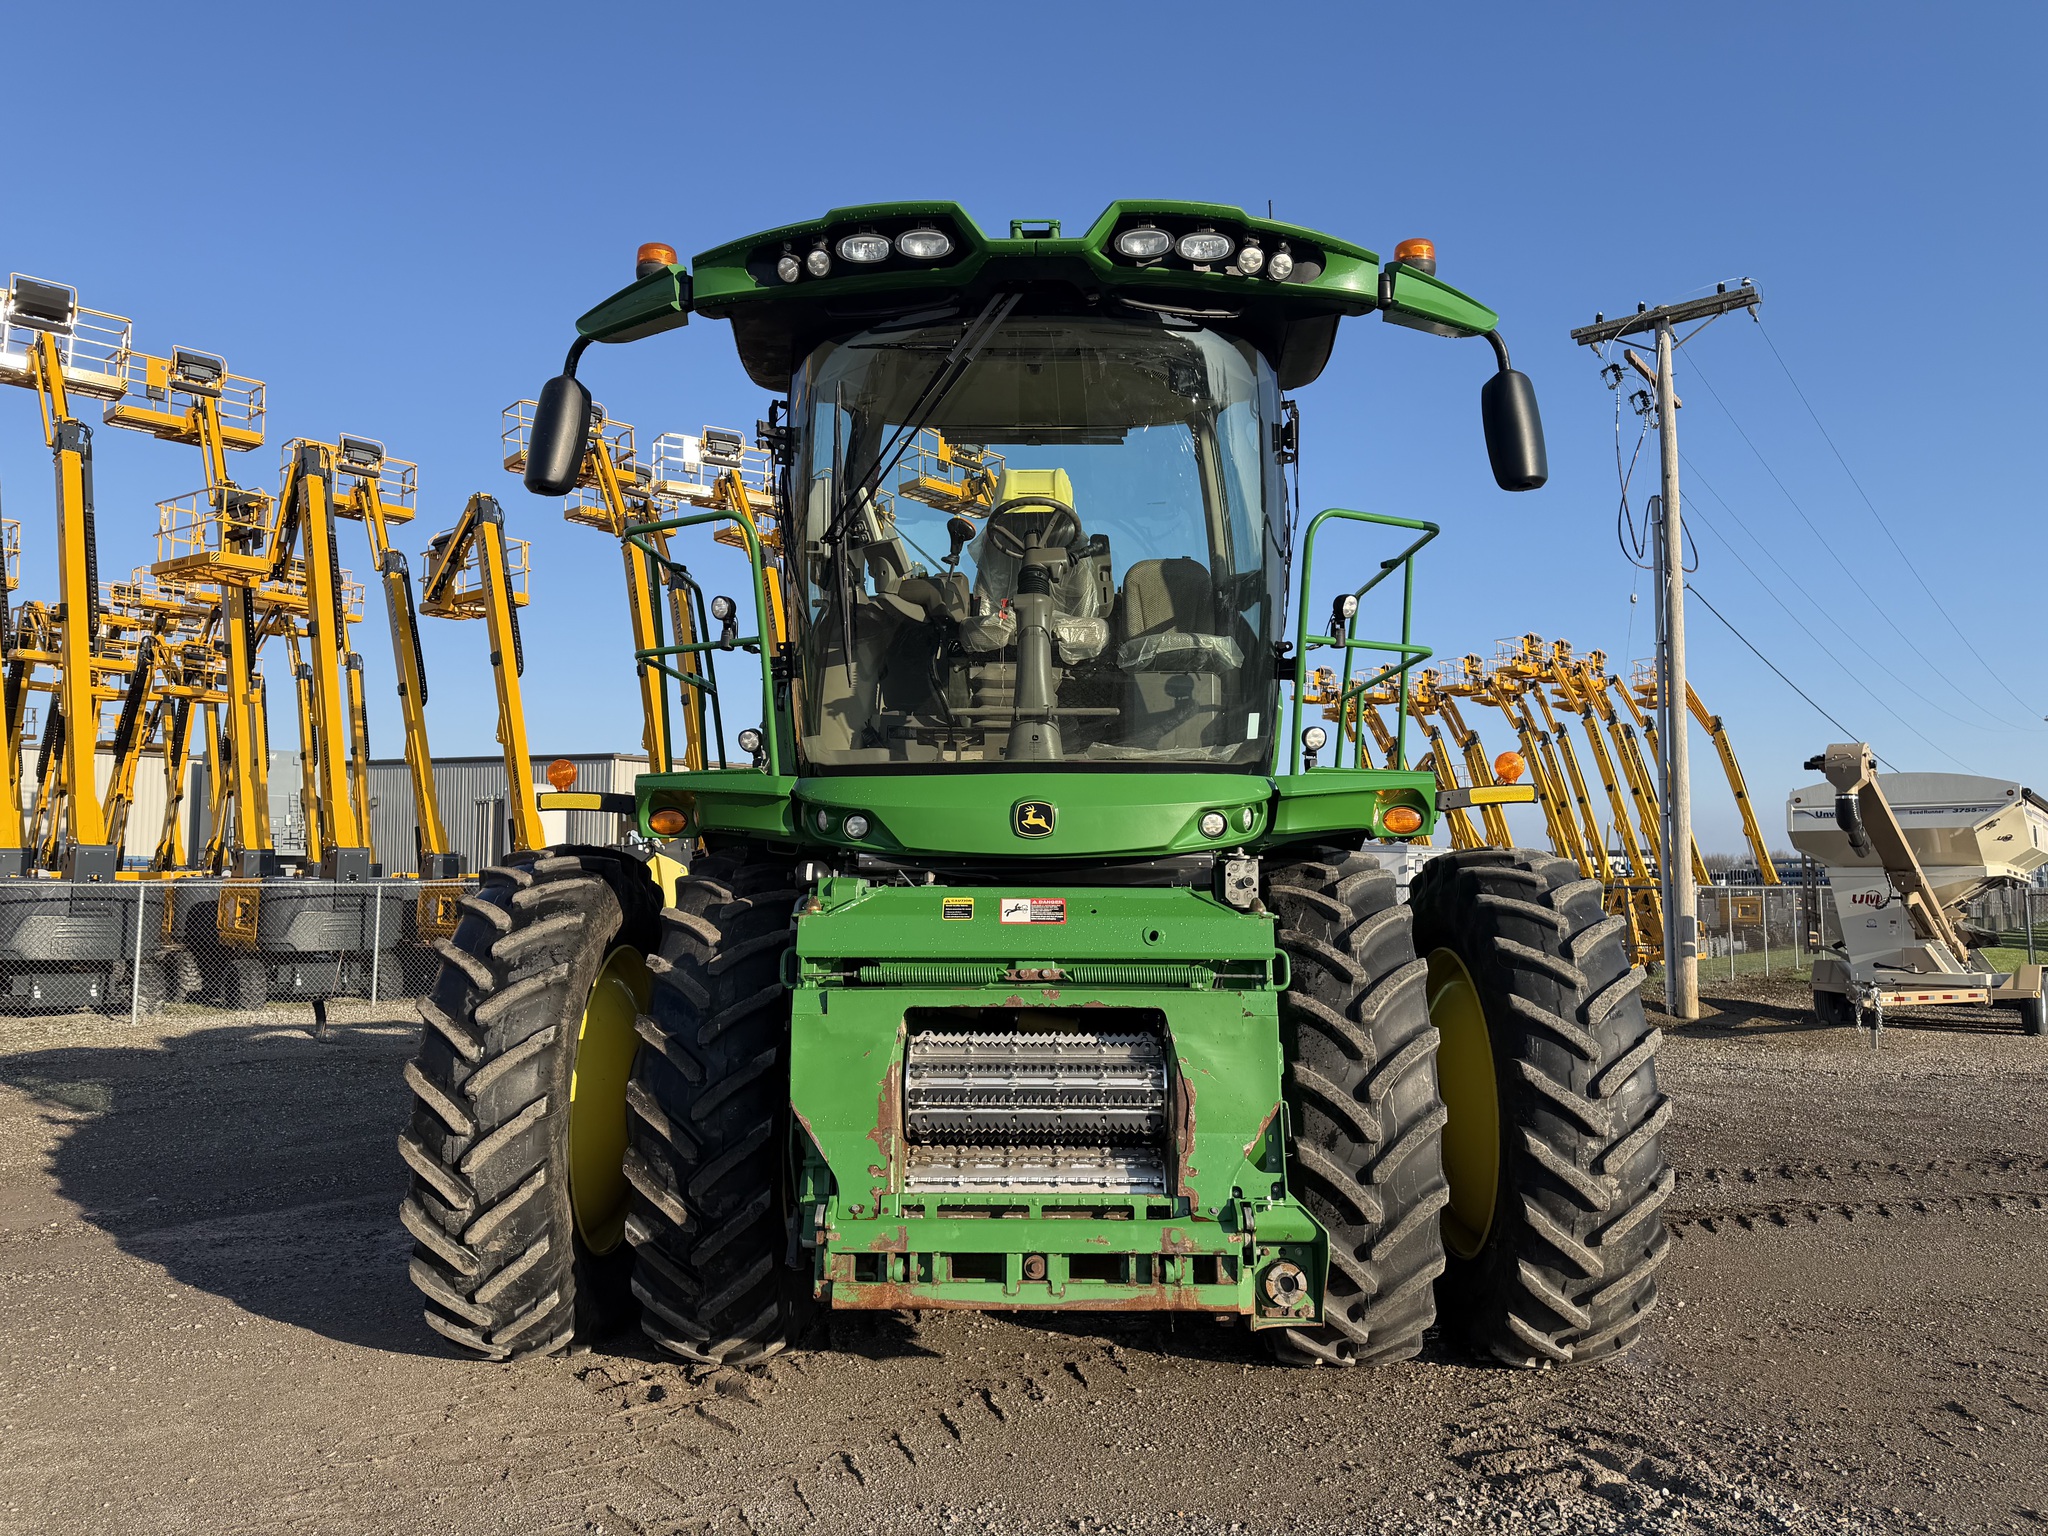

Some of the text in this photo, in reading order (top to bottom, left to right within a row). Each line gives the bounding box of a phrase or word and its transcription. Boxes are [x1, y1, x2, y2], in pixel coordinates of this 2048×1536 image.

[763, 576, 772, 603] HT46
[1590, 724, 1599, 740] HT46
[511, 756, 519, 789] Haulotte
[1852, 894, 1880, 904] UM
